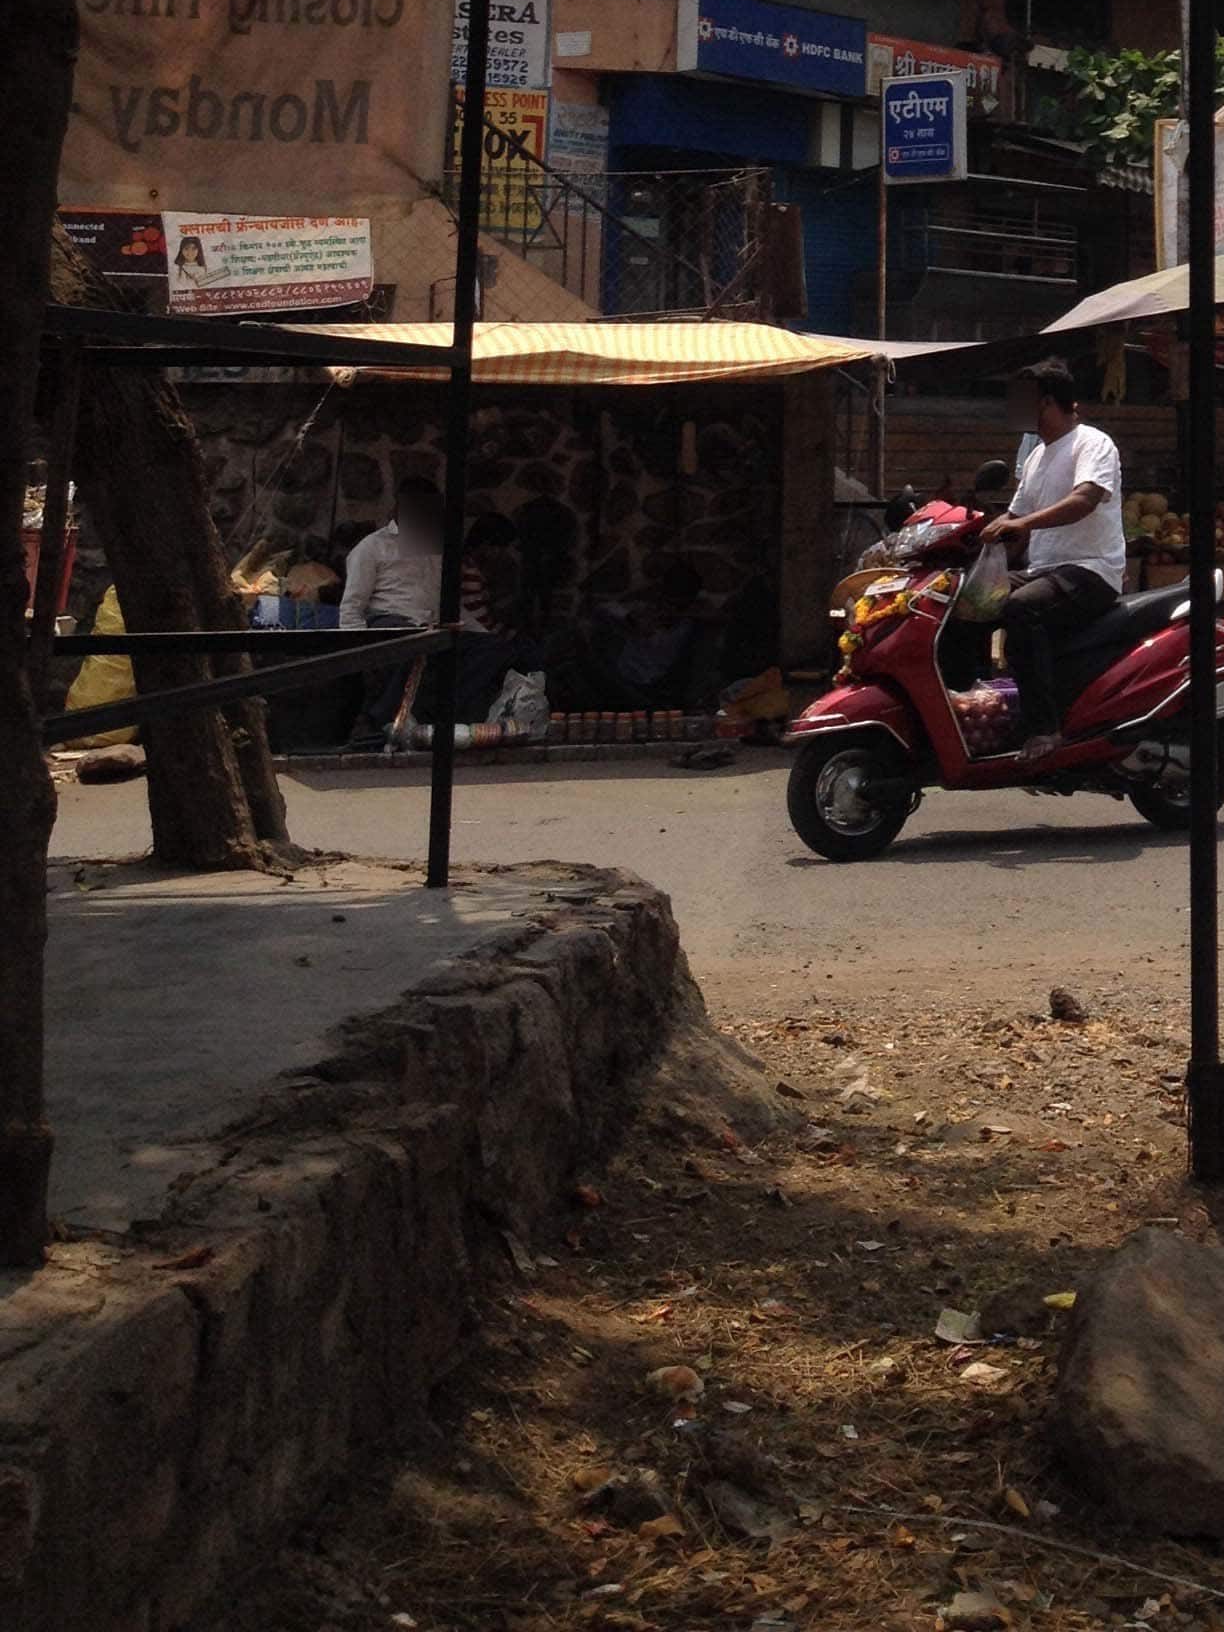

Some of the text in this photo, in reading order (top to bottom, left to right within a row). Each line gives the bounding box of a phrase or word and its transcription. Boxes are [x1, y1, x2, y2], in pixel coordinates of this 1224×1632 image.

[801, 42, 864, 64] HDFC BANK
[512, 93, 546, 110] POINT
[888, 90, 949, 124] एटीएम
